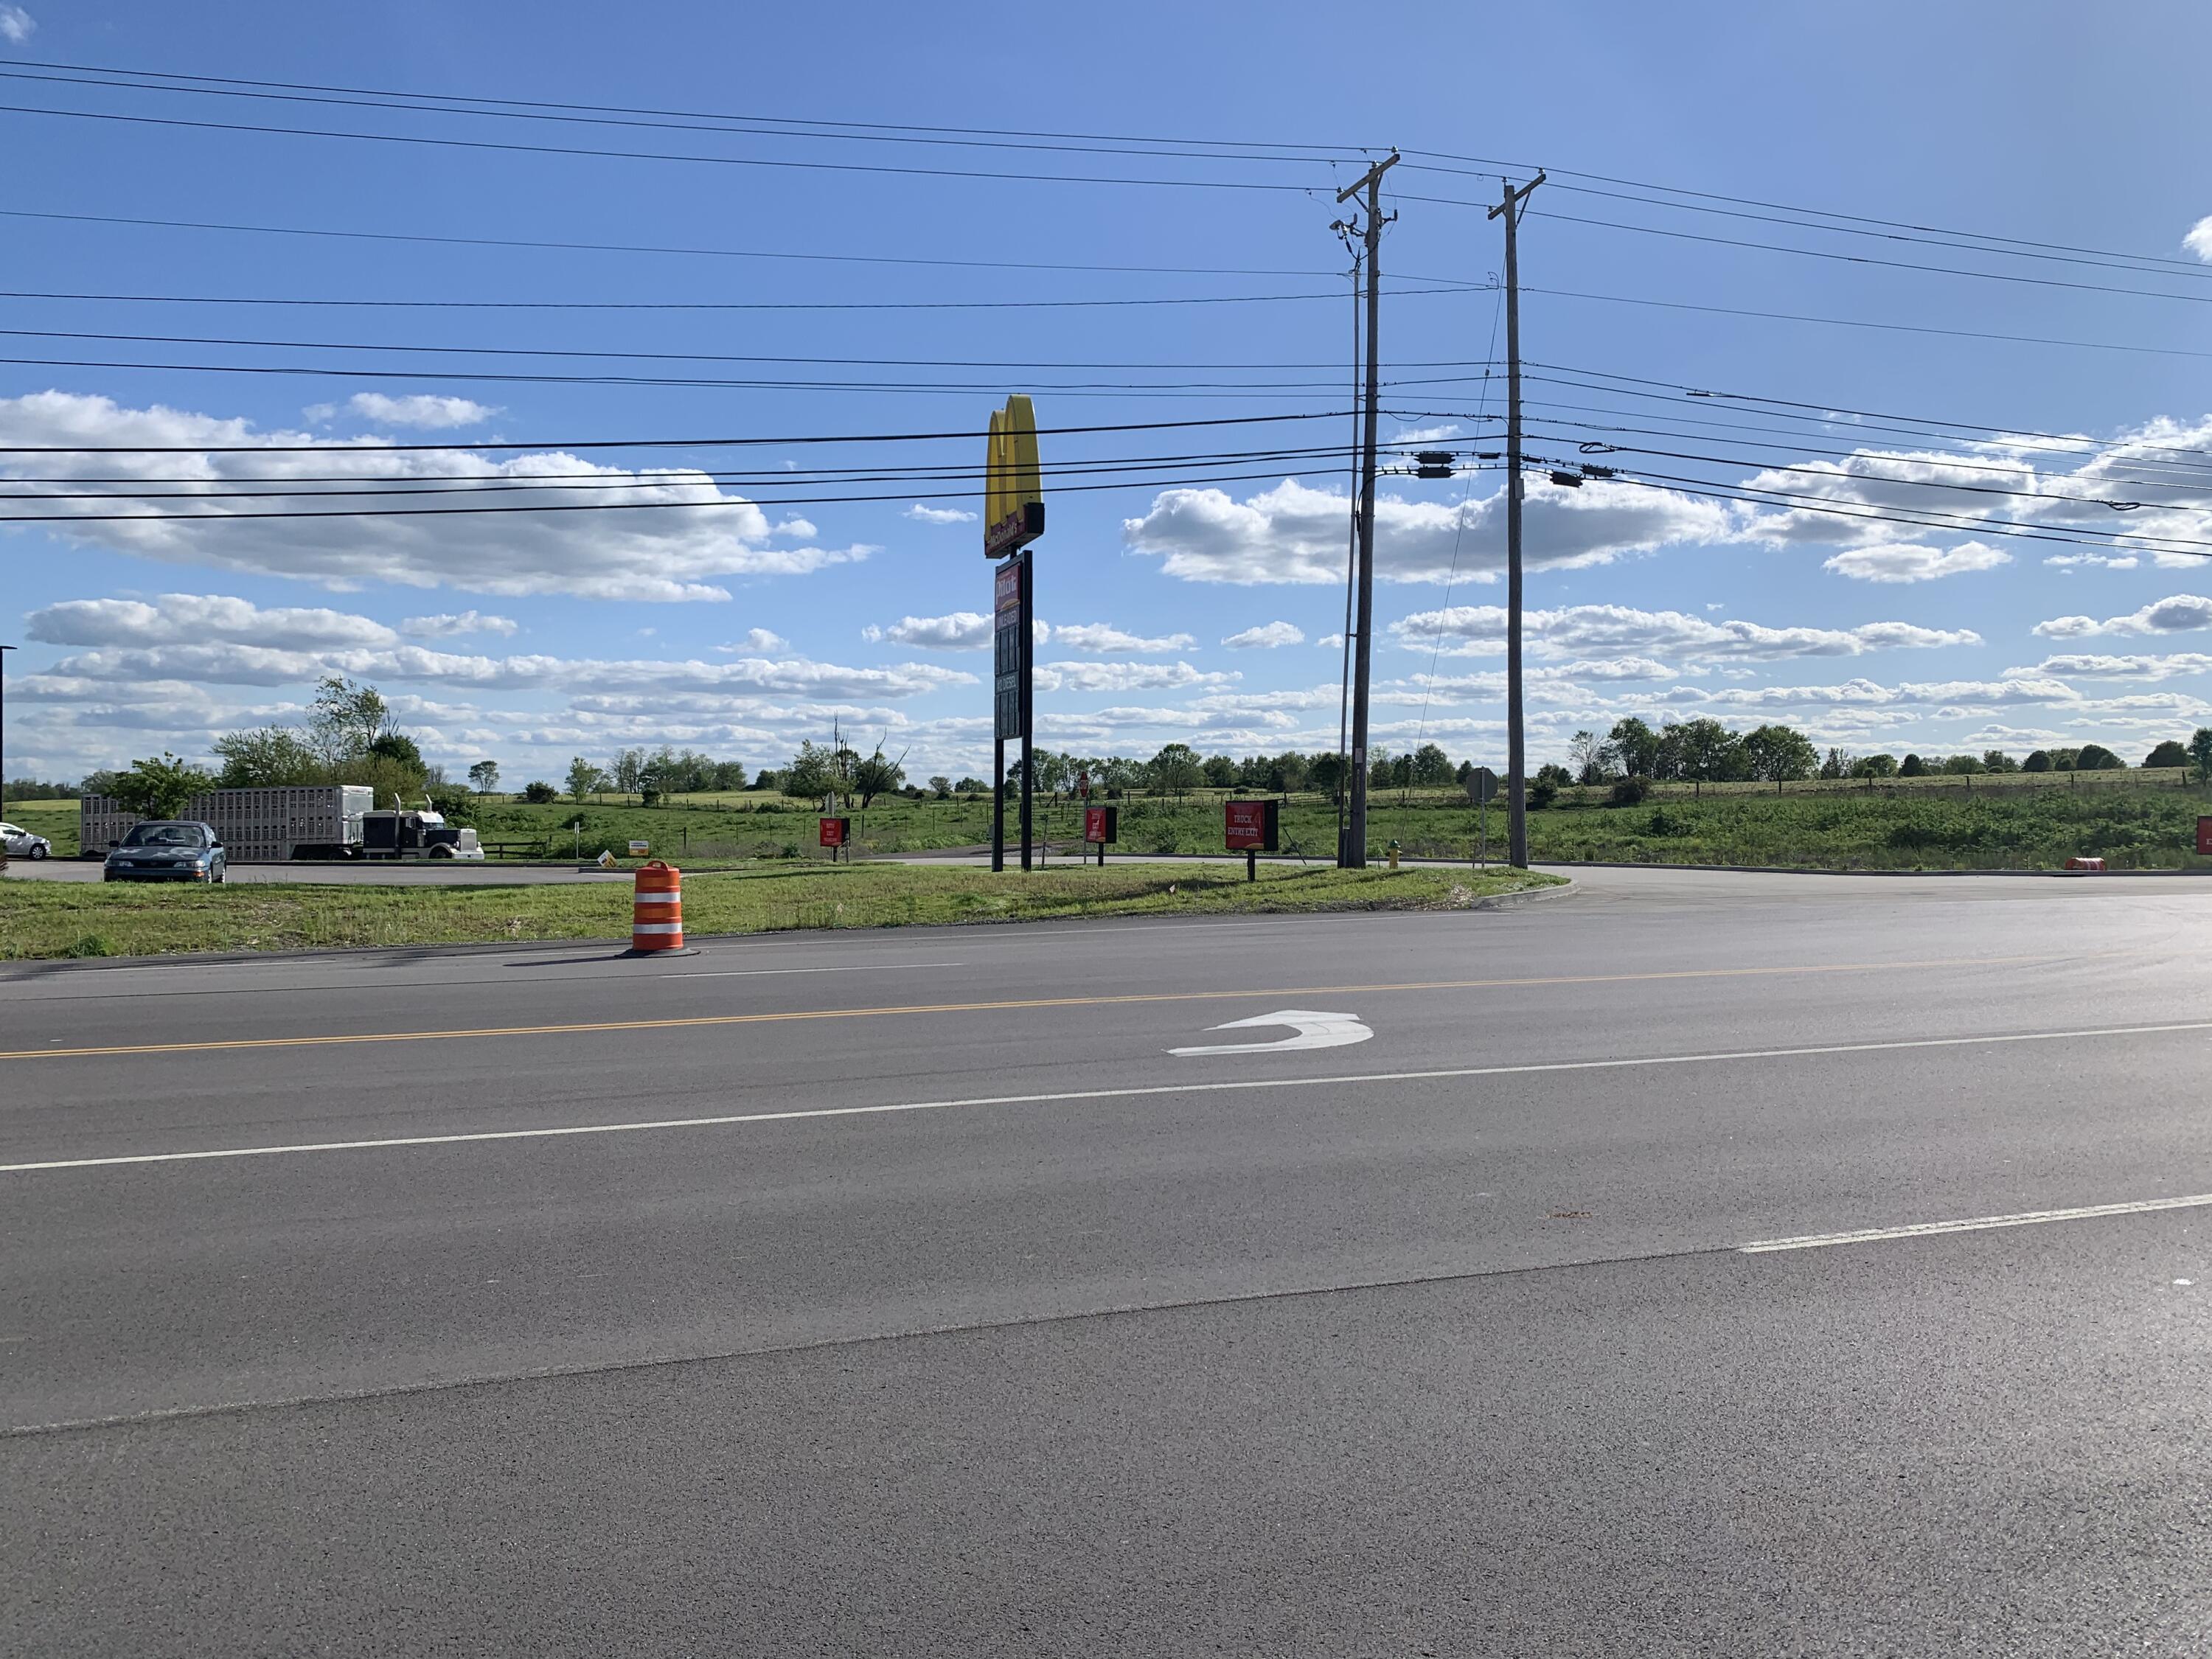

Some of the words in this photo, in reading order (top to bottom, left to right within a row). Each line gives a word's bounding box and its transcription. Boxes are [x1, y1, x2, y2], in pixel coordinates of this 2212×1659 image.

[990, 522, 1018, 549] McDonald's
[997, 610, 1016, 628] UNLEADED
[1003, 676, 1016, 690] DIESEL
[1234, 815, 1252, 824] TRUCK
